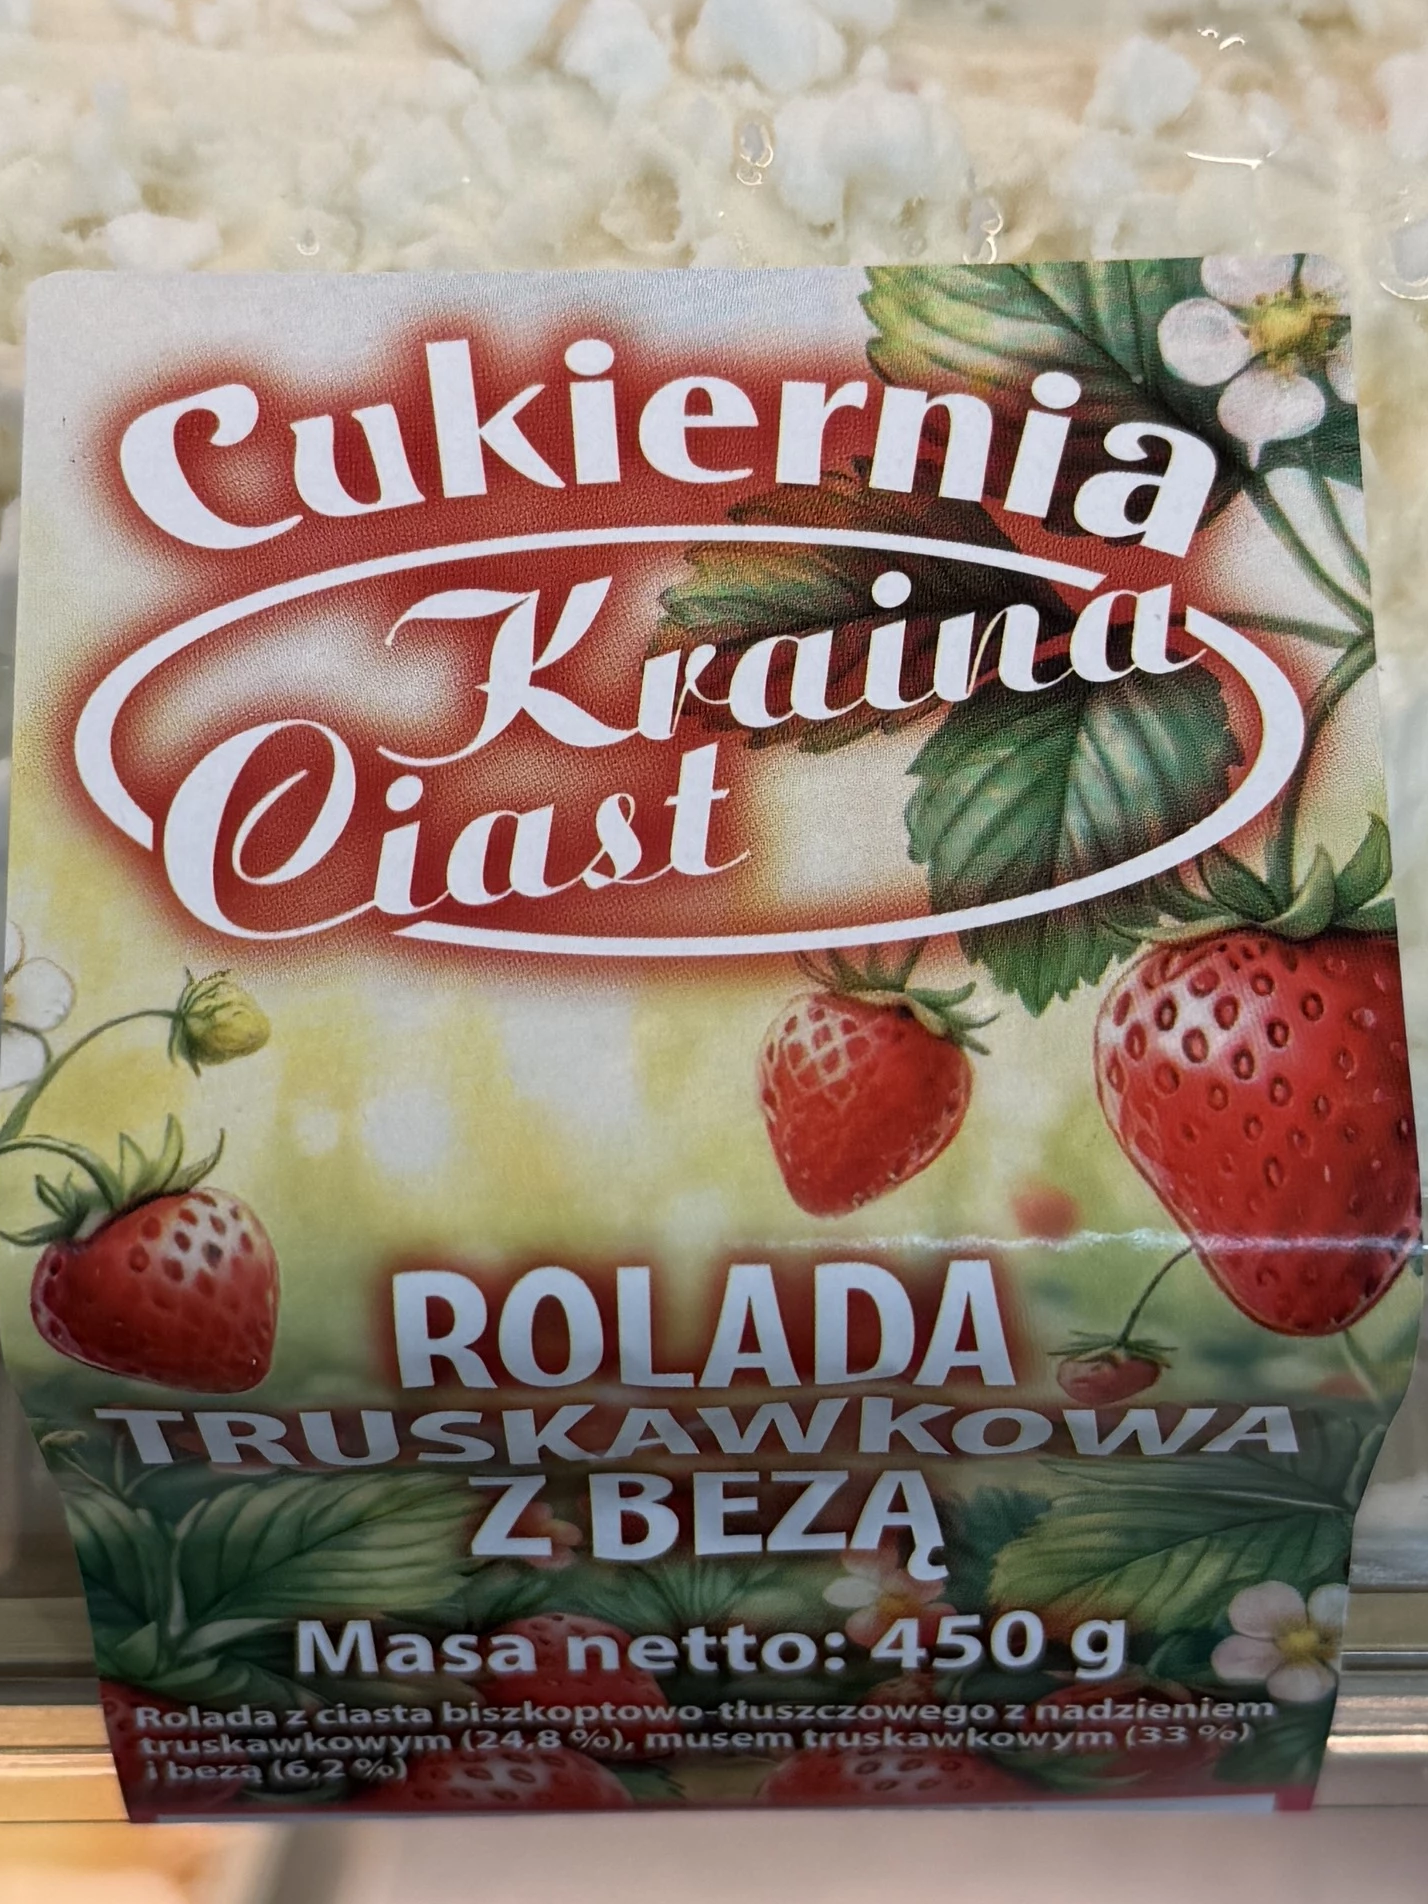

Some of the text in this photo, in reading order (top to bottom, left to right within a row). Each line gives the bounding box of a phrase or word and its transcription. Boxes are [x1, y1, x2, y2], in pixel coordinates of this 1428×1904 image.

[119, 339, 1219, 559] Cukiernia
[375, 570, 1209, 768] Kraina
[162, 718, 751, 941] Ciast
[391, 1258, 1017, 1392] ROLADA
[95, 1393, 1300, 1466] TRUSKAWKOWA
[470, 1469, 949, 1582] Z BEZĄ
[297, 1611, 1130, 1679] Masa netto: 450 g
[135, 1696, 1275, 1729] Rolada z ciasta biszkoptowo-tłuszczowego z nadzieniem
[139, 1730, 452, 1759] truskawkowym
[645, 1730, 794, 1751] musem
[802, 1724, 1114, 1753] truskawkowym
[147, 1758, 158, 1780] i
[167, 1758, 263, 1786] bezą
